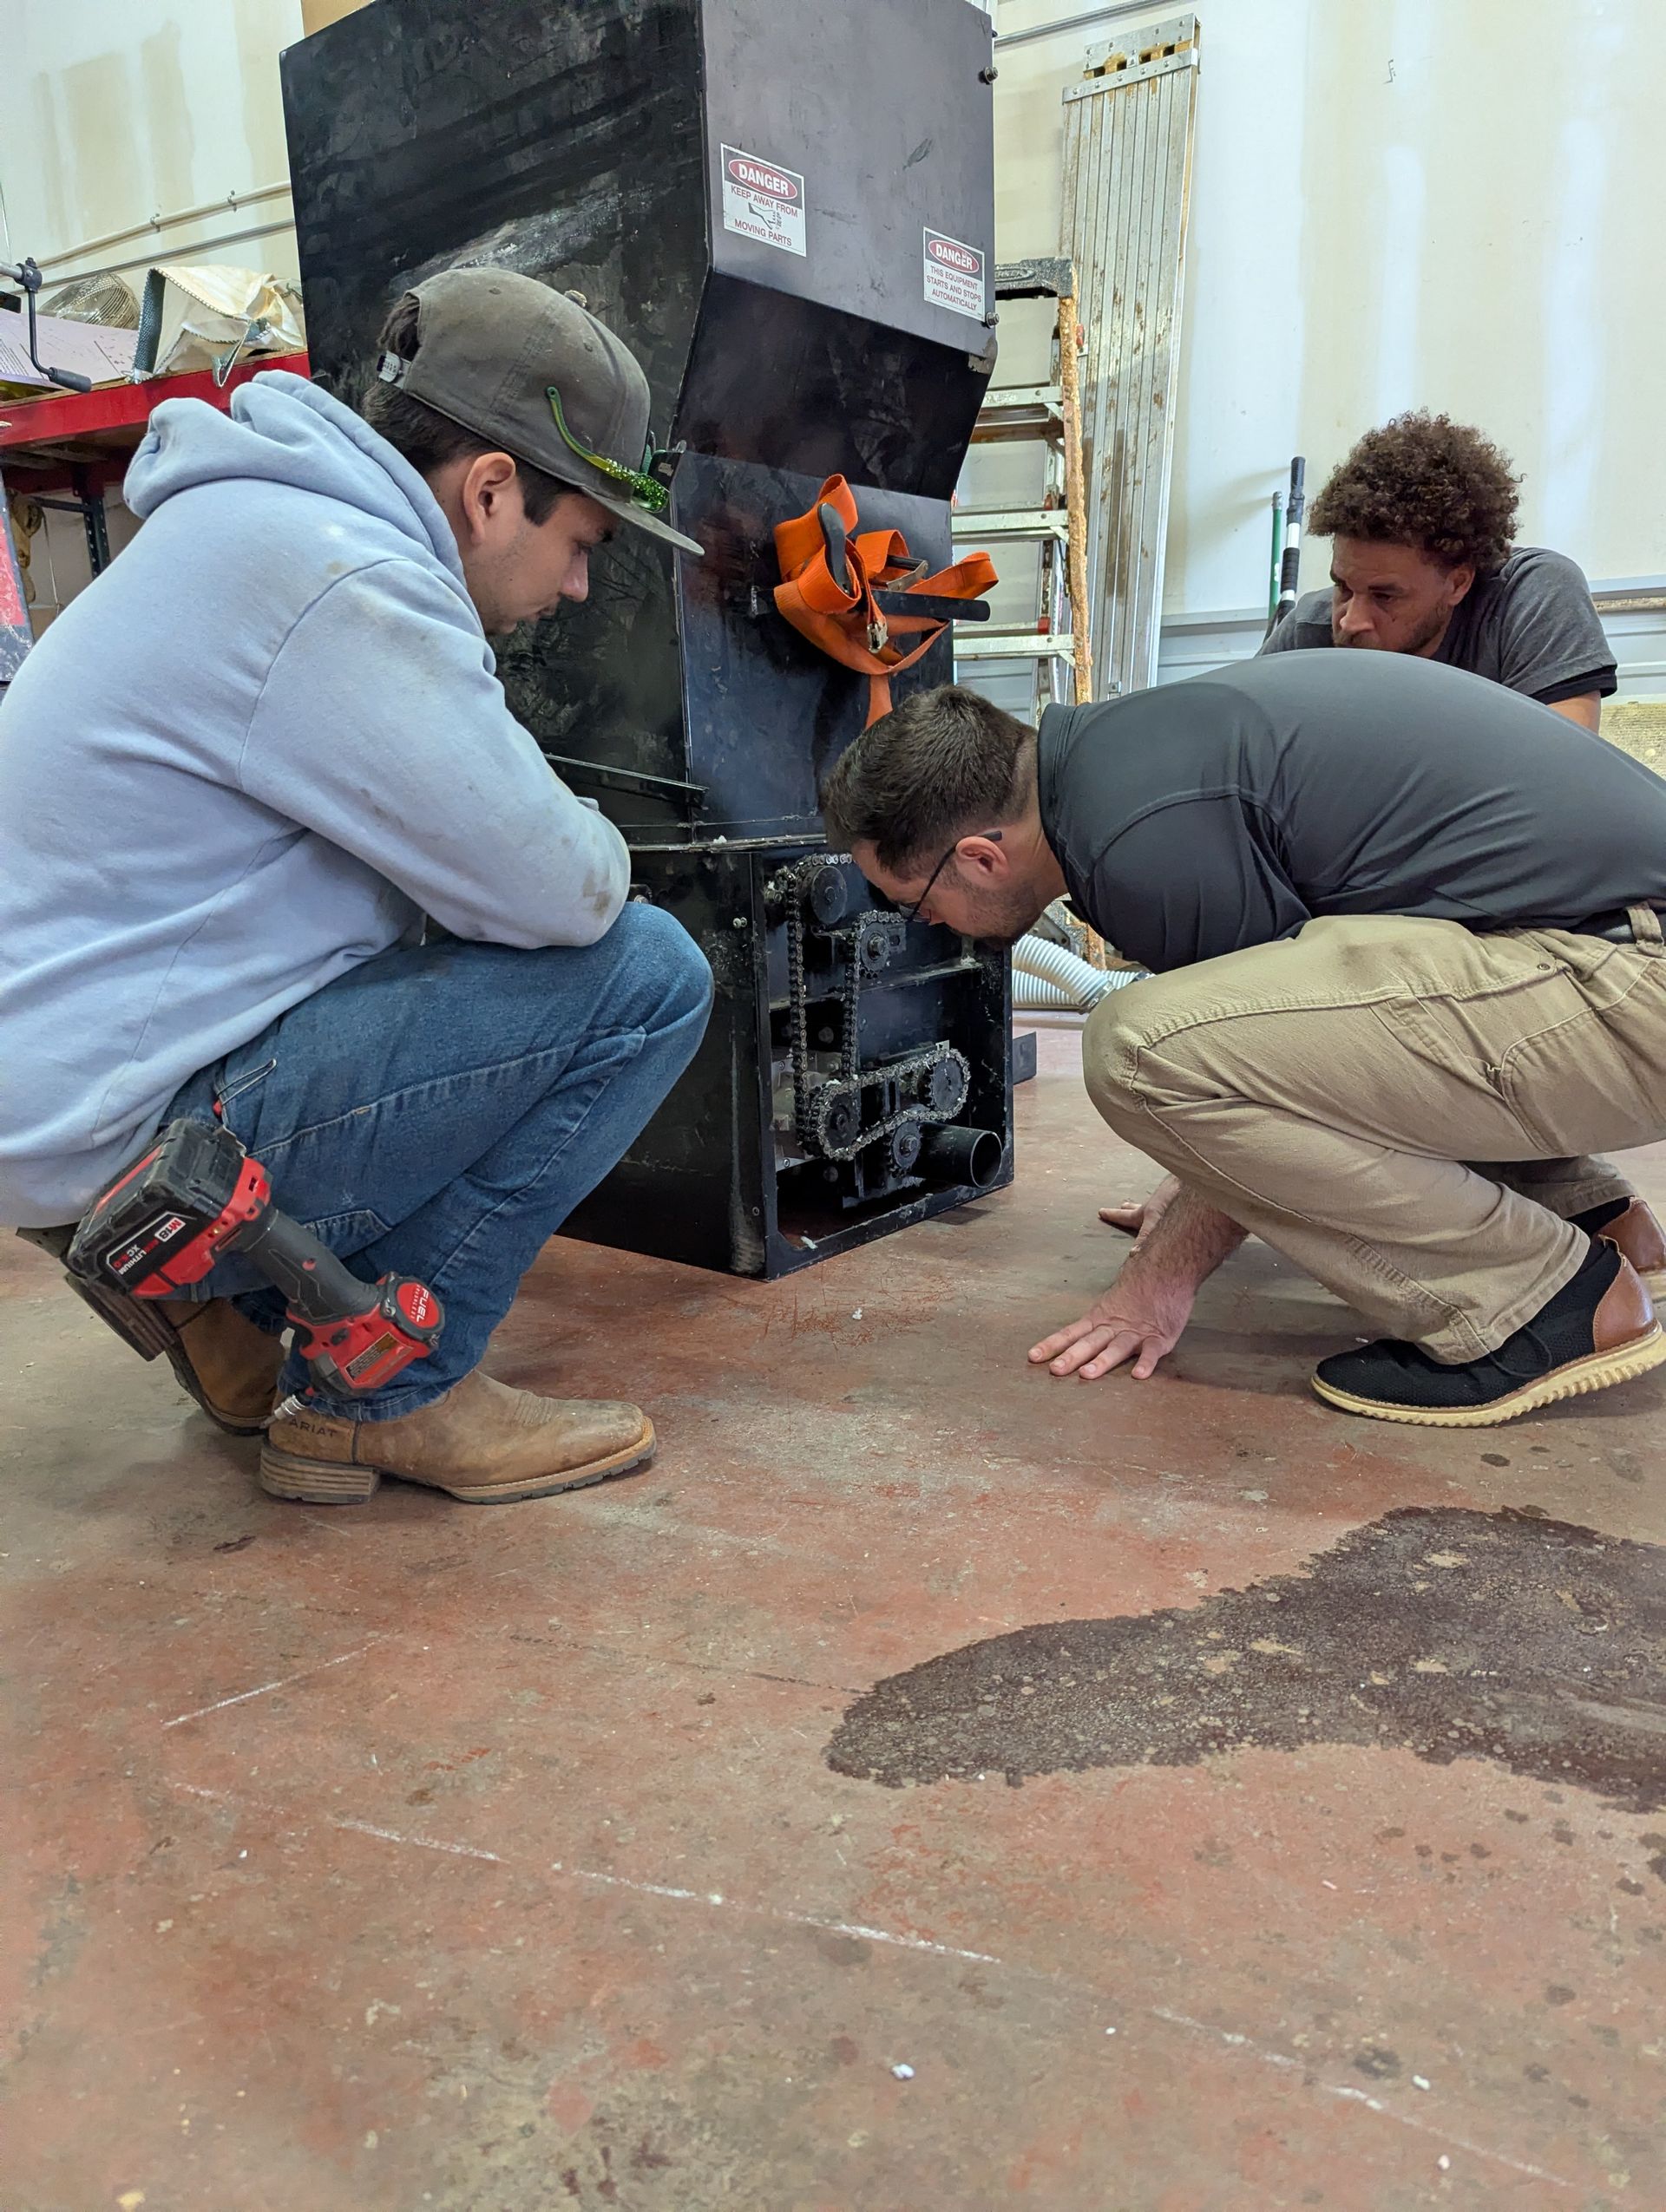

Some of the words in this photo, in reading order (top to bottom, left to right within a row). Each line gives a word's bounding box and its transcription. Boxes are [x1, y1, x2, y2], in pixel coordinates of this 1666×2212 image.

[738, 163, 789, 196] DANGER
[731, 185, 751, 200] KEEP
[753, 194, 775, 209] AWAY
[776, 202, 797, 218] FROM
[735, 219, 766, 238] MOVING
[769, 231, 792, 246] PARTS
[935, 244, 973, 270] DANGER
[926, 275, 948, 290] STARTS
[949, 285, 962, 296] AND
[963, 290, 981, 303] STOPS
[930, 265, 944, 278] THIS
[945, 271, 978, 291] EQUIPMENT
[931, 289, 977, 311] AUTOMATICALLY
[158, 1219, 182, 1240] M18
[416, 1287, 429, 1322] FUEL
[289, 1418, 338, 1437] ARIAT
